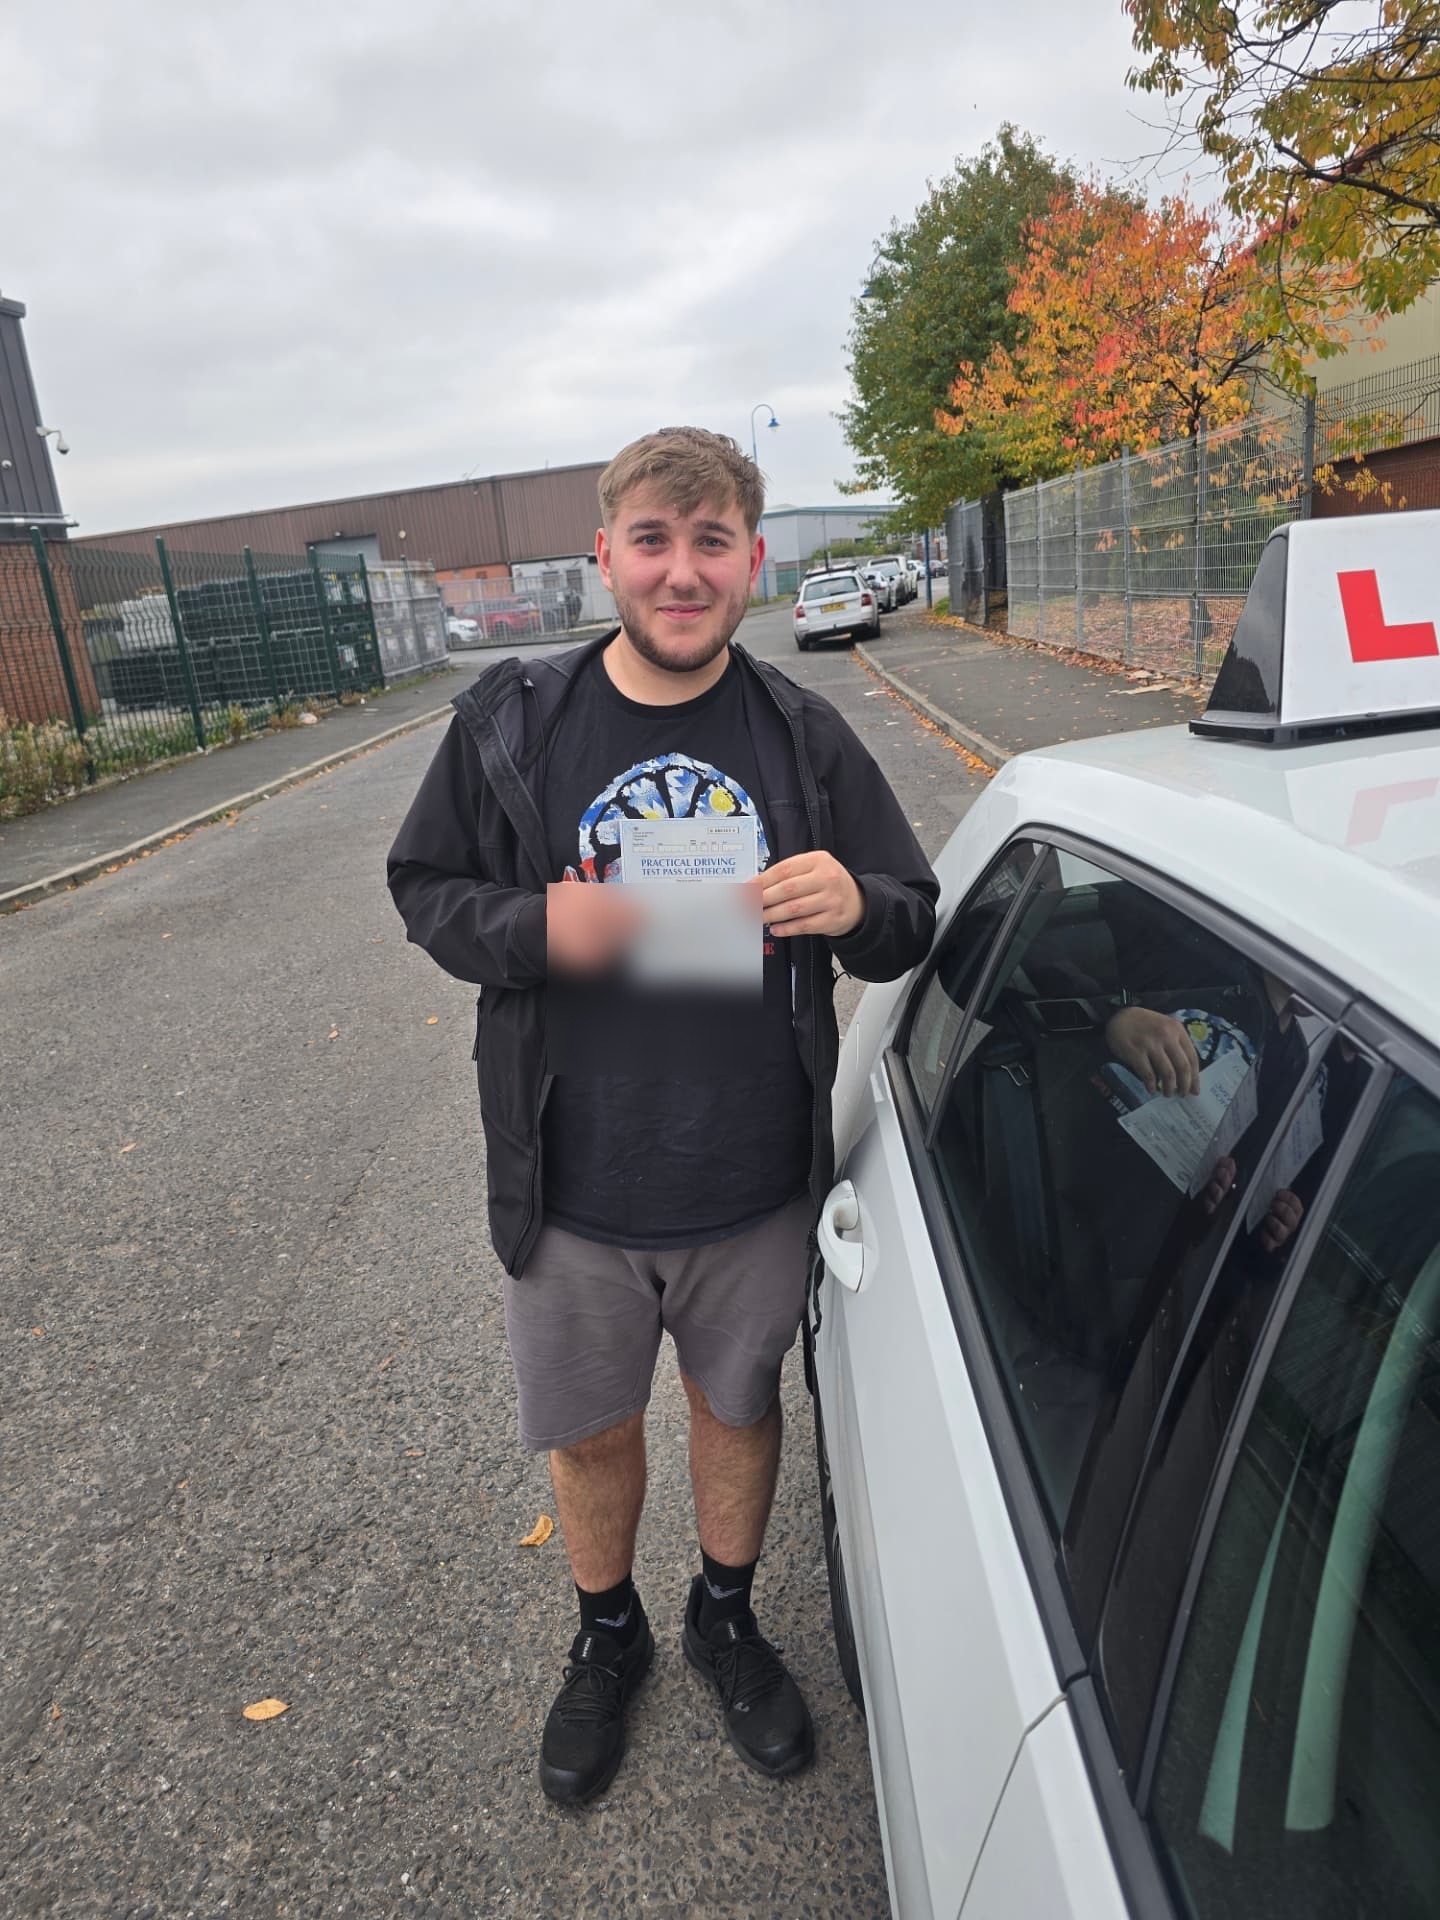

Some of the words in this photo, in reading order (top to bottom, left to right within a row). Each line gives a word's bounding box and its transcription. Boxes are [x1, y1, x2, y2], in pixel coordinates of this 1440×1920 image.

[1336, 569, 1439, 663] L
[641, 858, 692, 867] PRACTICAL
[694, 857, 736, 866] DRIVING
[642, 868, 660, 876] TEST
[662, 868, 682, 876] PASS
[684, 867, 736, 876] CERTIFICATE
